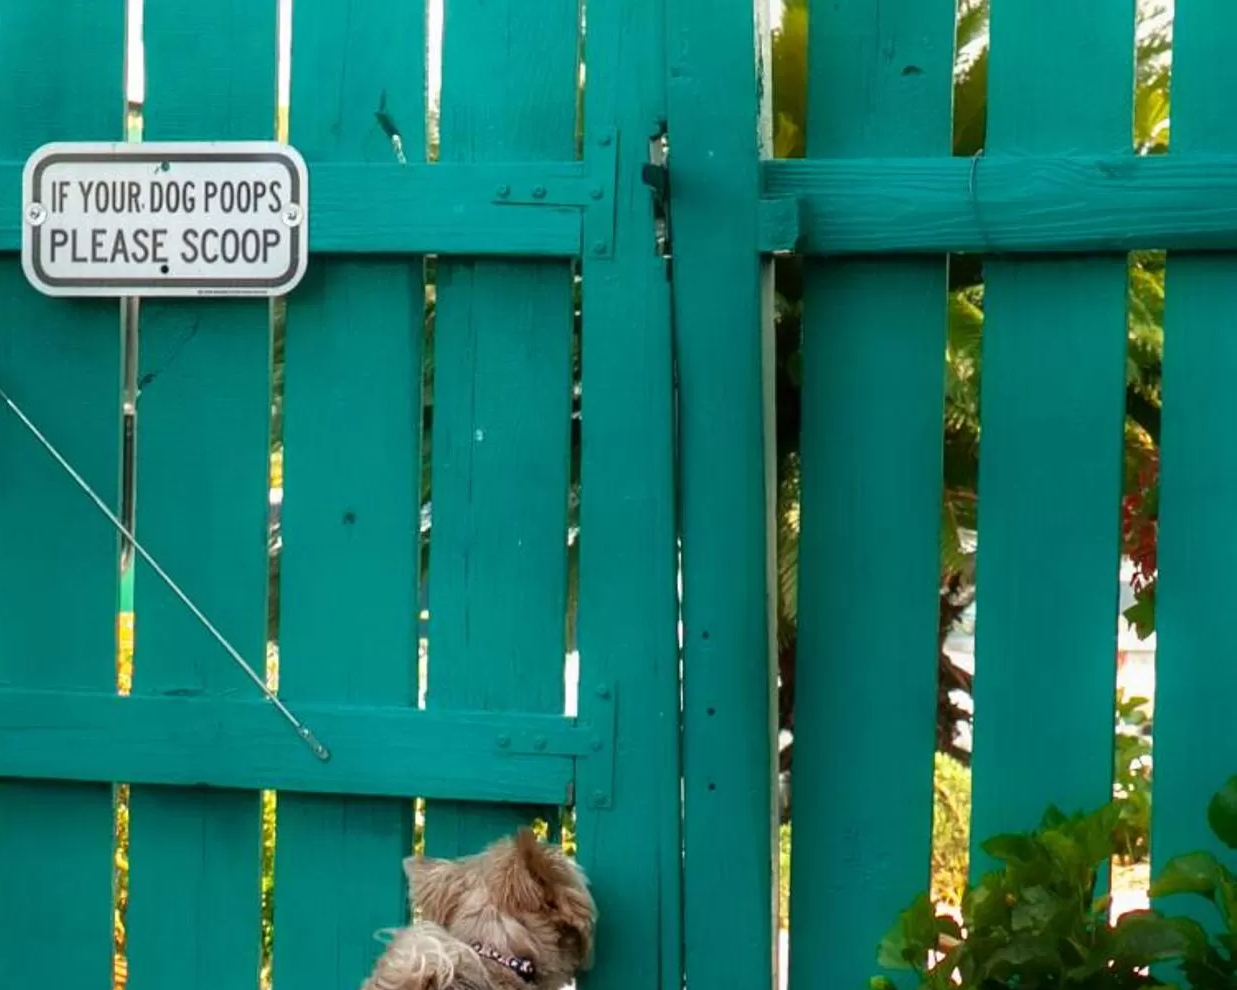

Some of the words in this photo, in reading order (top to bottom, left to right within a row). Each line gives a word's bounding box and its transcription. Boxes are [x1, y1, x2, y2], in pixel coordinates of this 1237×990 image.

[51, 180, 71, 214] IF
[78, 180, 142, 214] YOUR
[150, 180, 196, 214] DOG
[203, 180, 283, 214] POOPS
[49, 228, 169, 264] PLEASE
[180, 228, 282, 264] SCOOP
